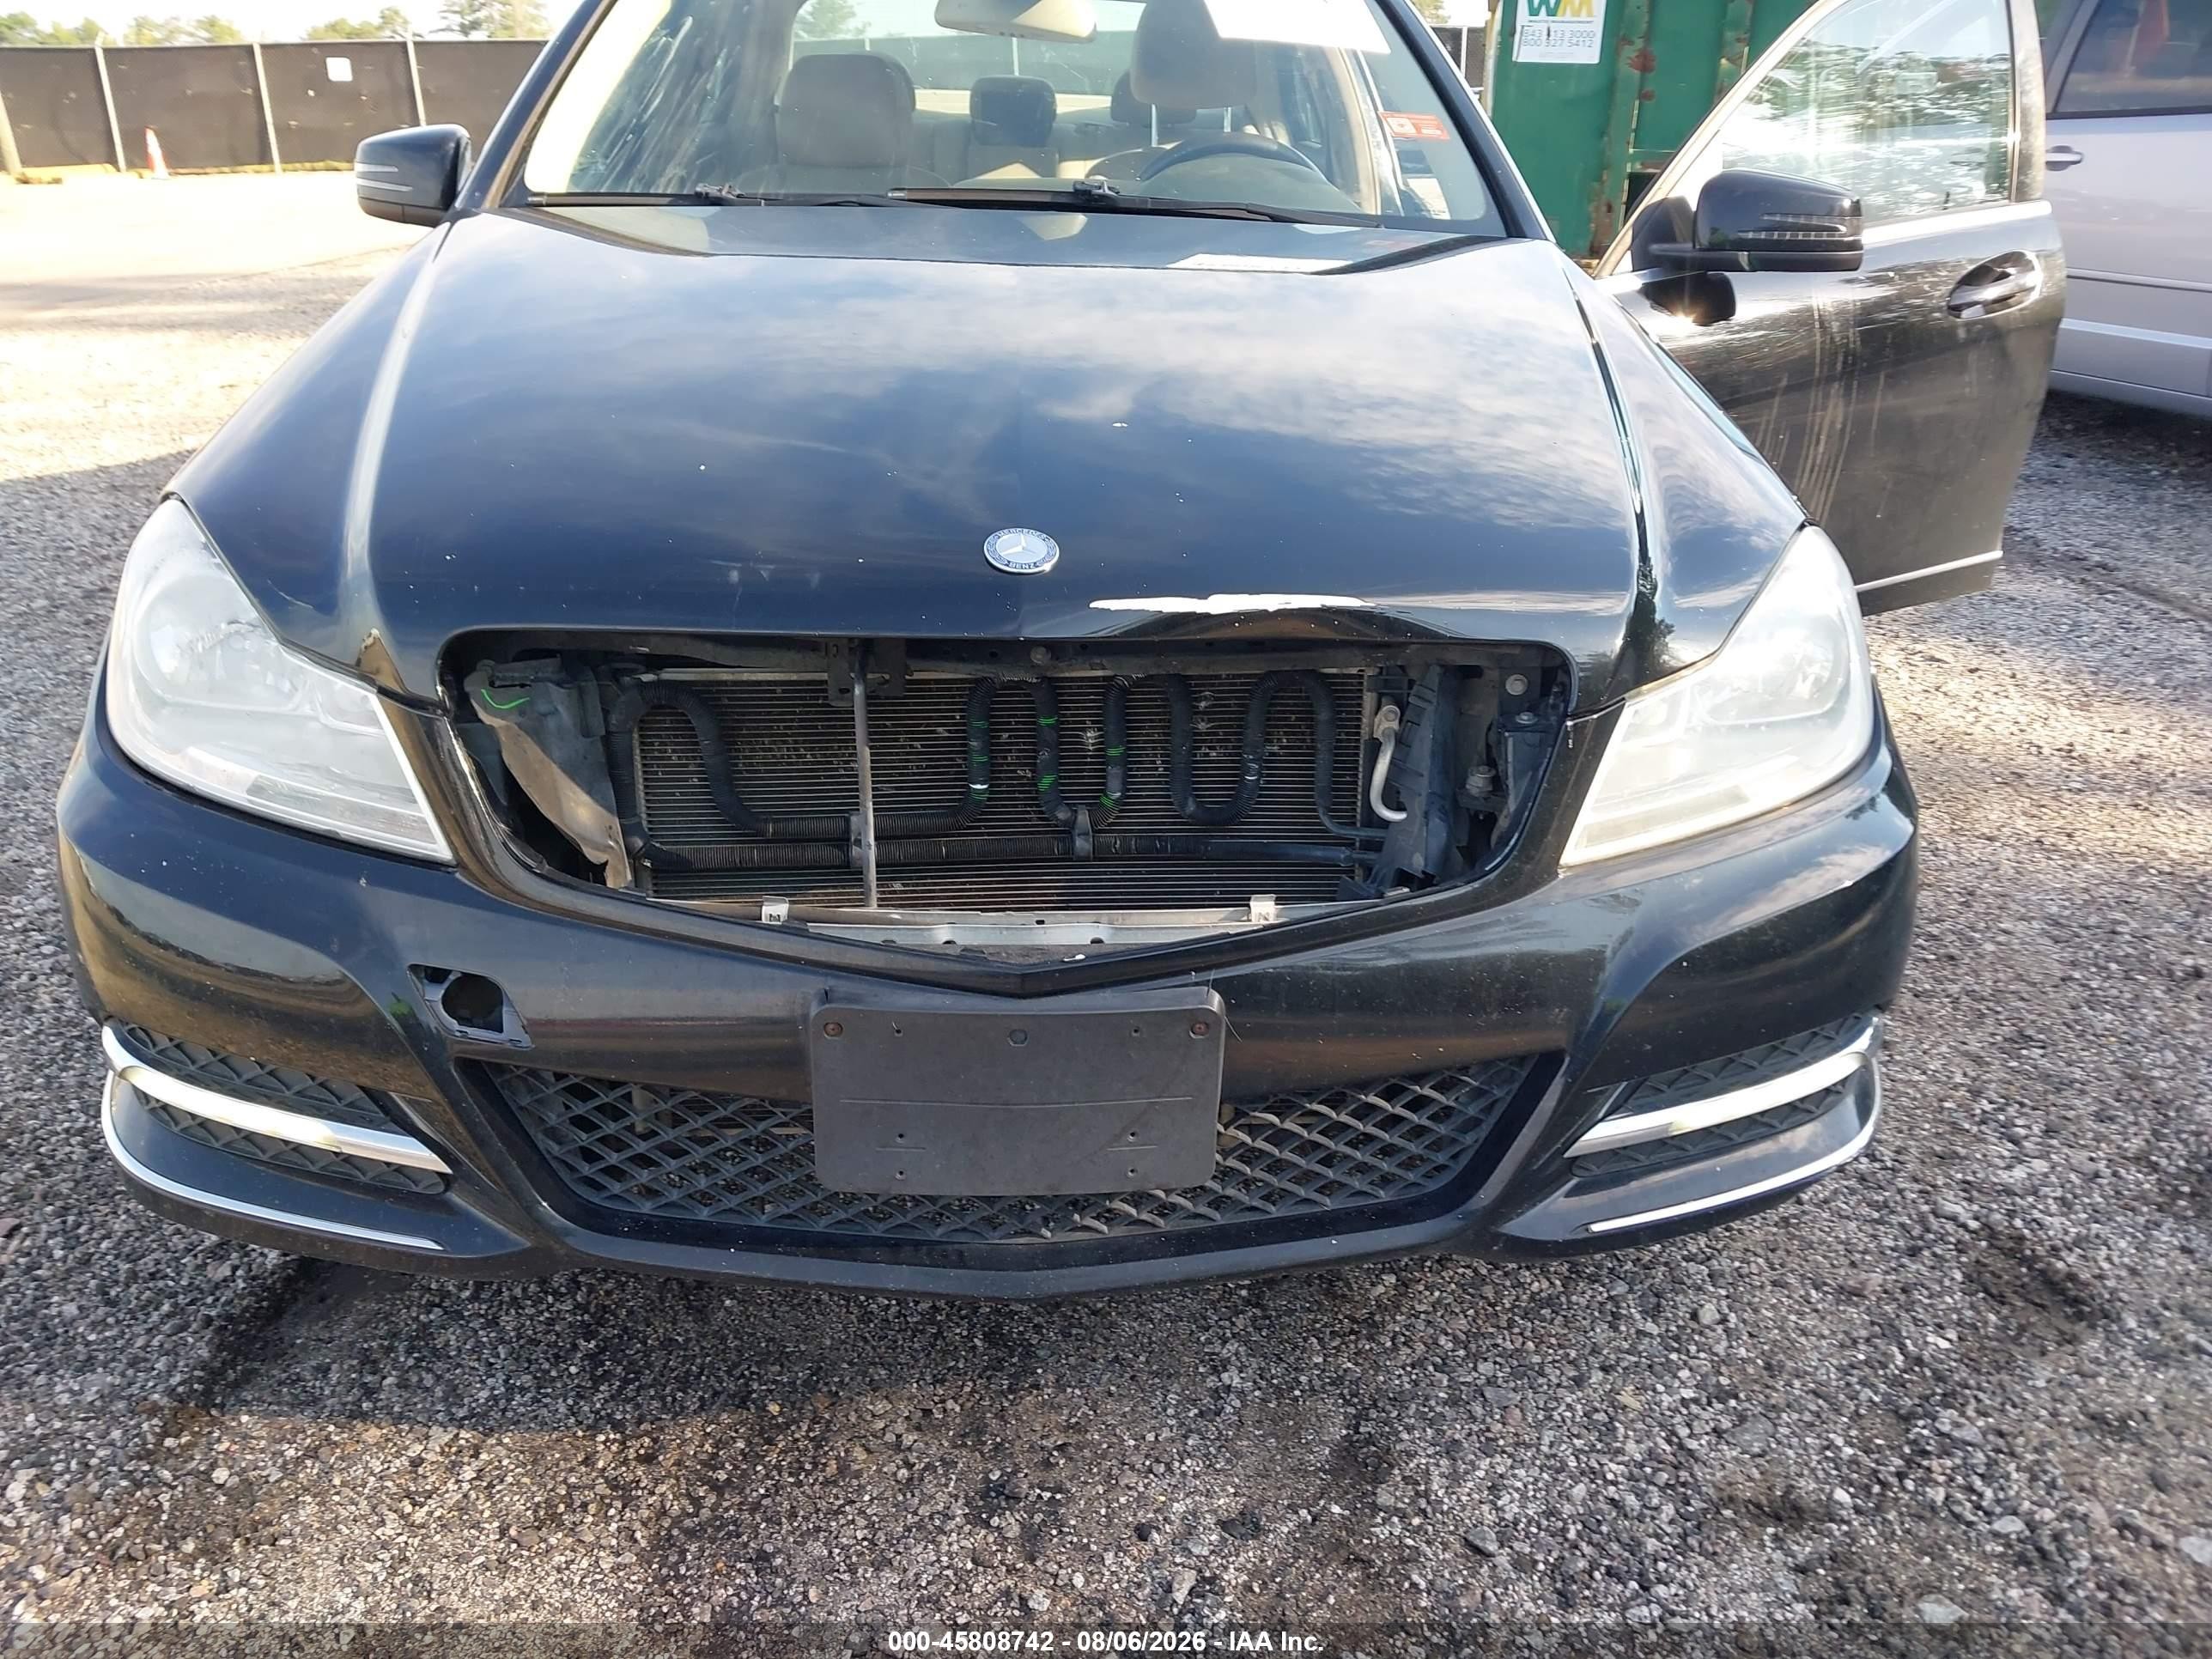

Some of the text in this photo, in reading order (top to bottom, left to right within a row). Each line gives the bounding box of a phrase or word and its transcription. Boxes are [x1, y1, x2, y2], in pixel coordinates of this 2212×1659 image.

[1528, 0, 1595, 17] WM
[1569, 29, 1595, 39] 3000
[1566, 40, 1595, 48] 5412
